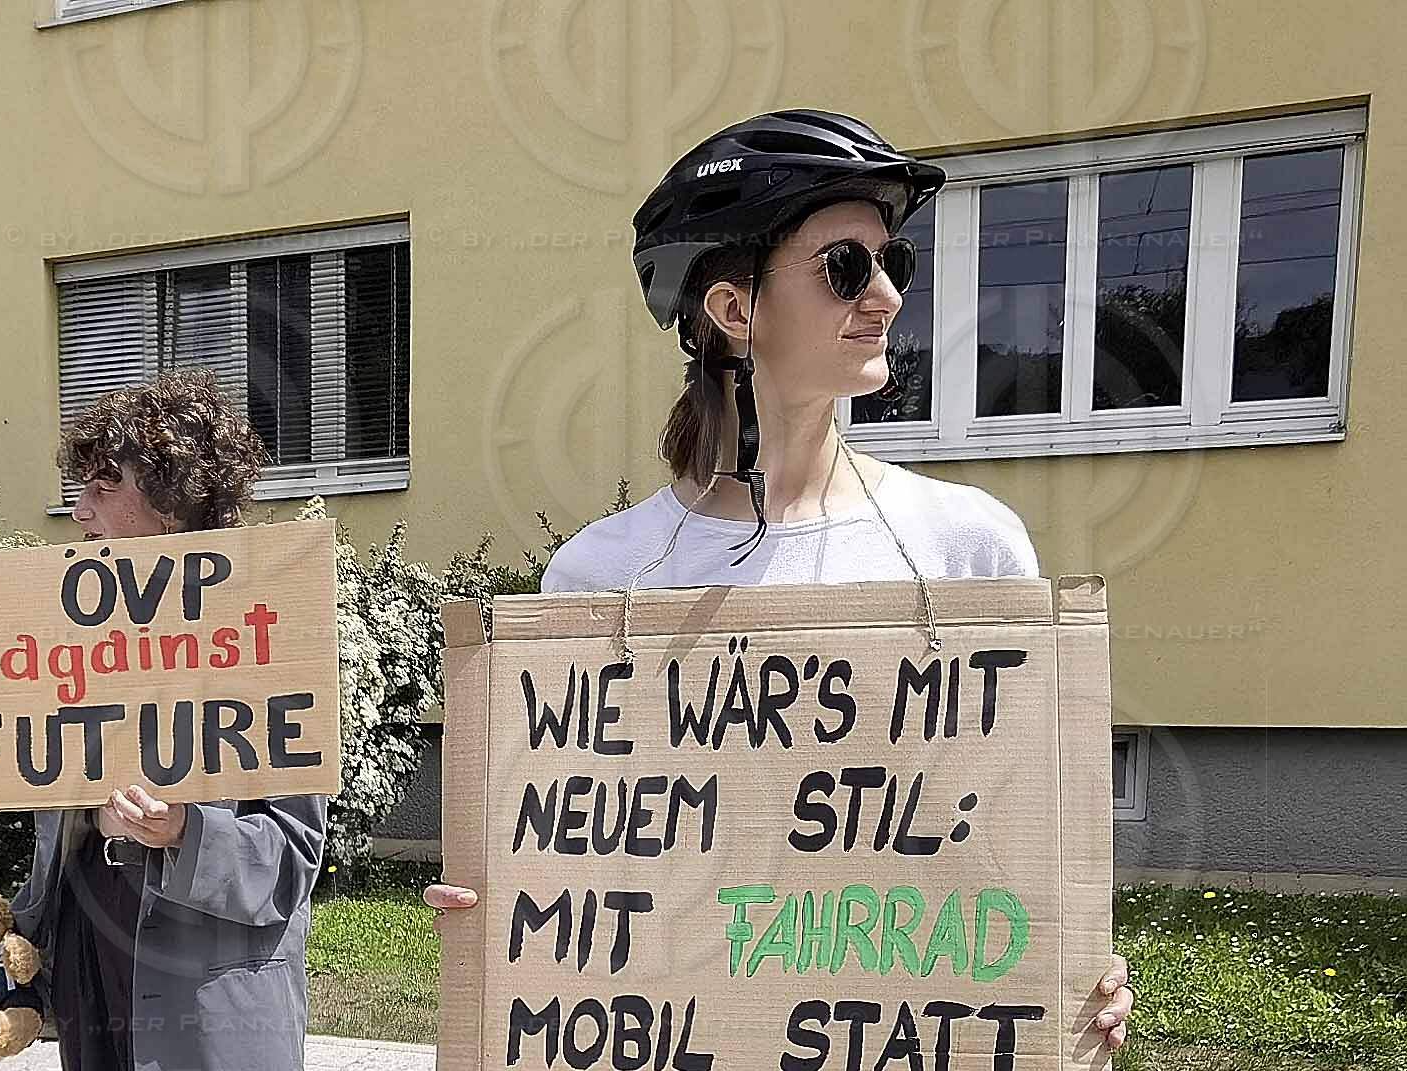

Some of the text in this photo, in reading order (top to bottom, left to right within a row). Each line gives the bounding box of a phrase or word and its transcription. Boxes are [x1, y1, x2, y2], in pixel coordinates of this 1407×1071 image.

[696, 158, 744, 178] uvex
[61, 546, 232, 627] ÖVP
[0, 603, 278, 704] against
[520, 661, 634, 756] WIE
[890, 650, 1028, 745] MIT
[511, 766, 978, 857] NEUEM STIL:
[508, 884, 1029, 982] MIT FAHRRAD
